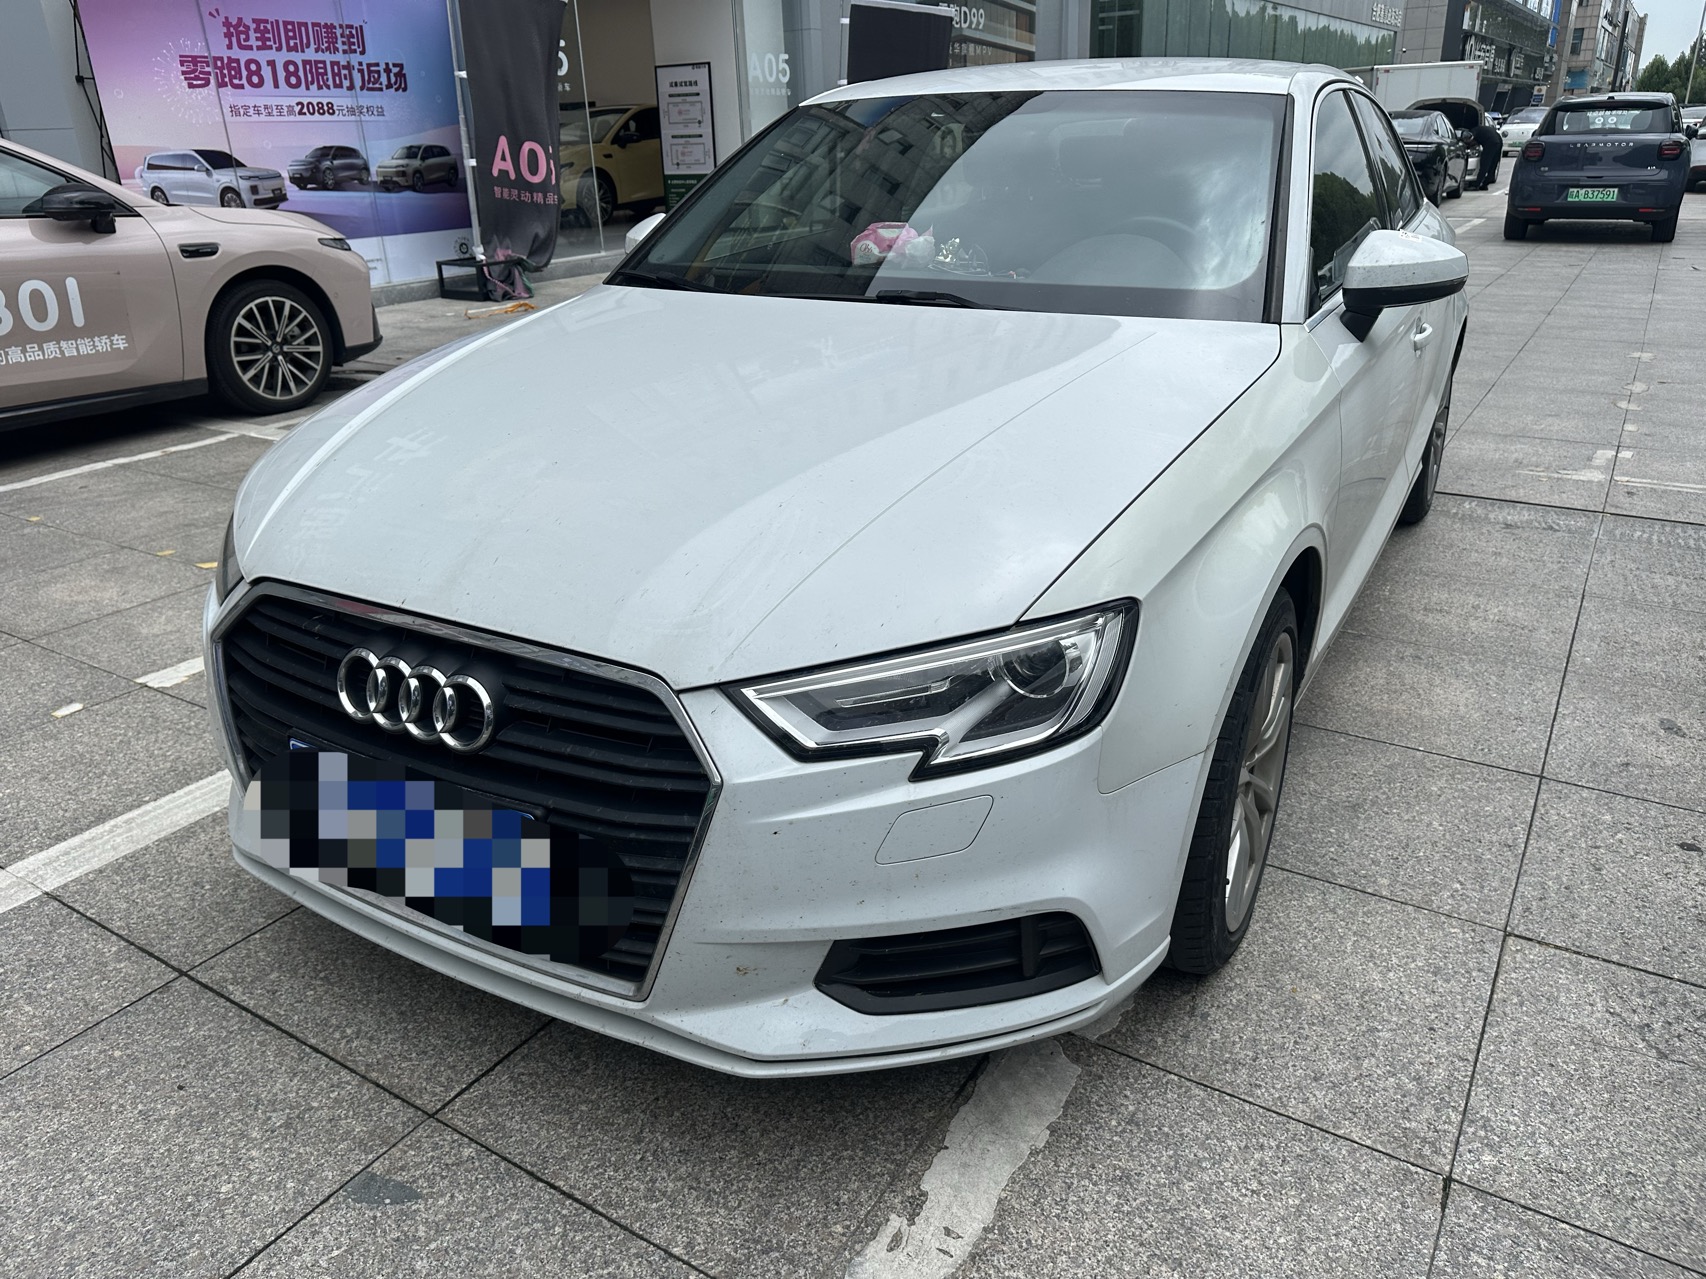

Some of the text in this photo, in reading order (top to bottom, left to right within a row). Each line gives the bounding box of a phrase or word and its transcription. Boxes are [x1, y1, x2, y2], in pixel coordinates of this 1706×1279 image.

[222, 16, 366, 55] 抢到即赚到
[178, 54, 409, 92] 零跑818限时返场
[748, 52, 790, 83] A05
[228, 100, 386, 118] 指定车型至高2088元抽奖权益
[491, 135, 556, 185] A0
[0, 276, 85, 336] 01
